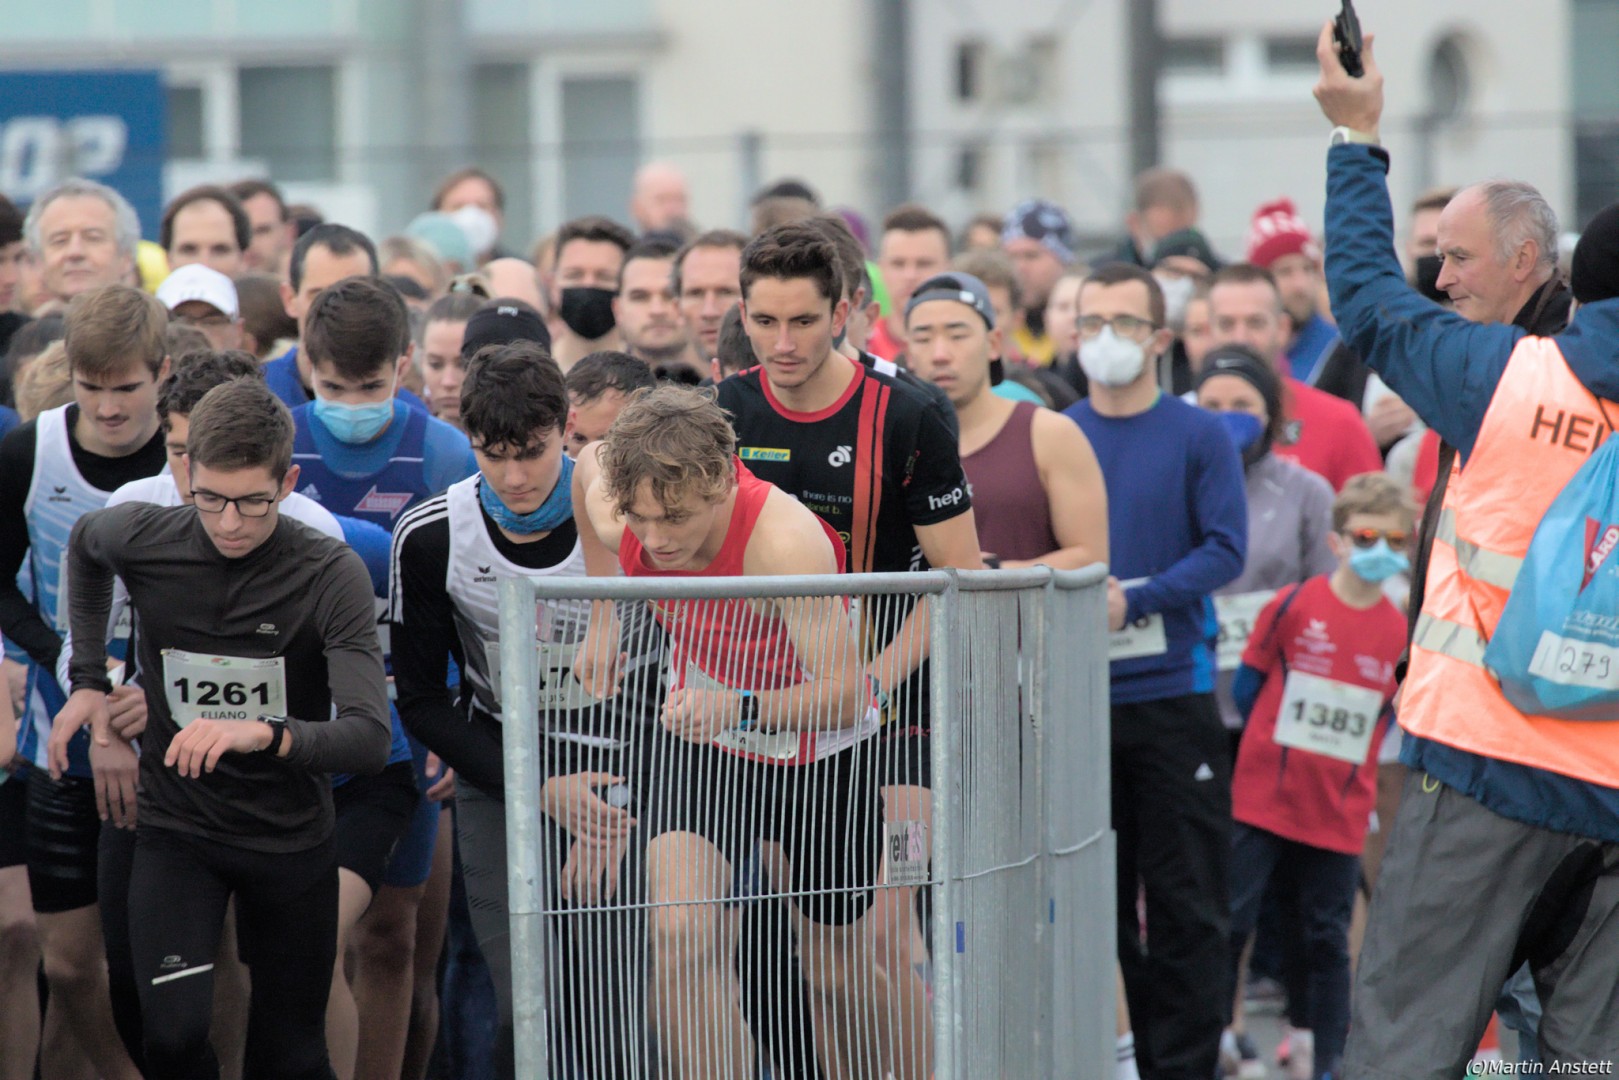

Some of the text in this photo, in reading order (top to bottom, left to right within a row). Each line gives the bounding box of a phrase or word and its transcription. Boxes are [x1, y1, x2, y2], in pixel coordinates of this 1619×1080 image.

[752, 449, 788, 460] Keller
[837, 494, 853, 505] no
[805, 501, 830, 514] lanet
[174, 676, 269, 706] 1261
[201, 710, 248, 720] ELIANO
[1292, 698, 1367, 738] 1383
